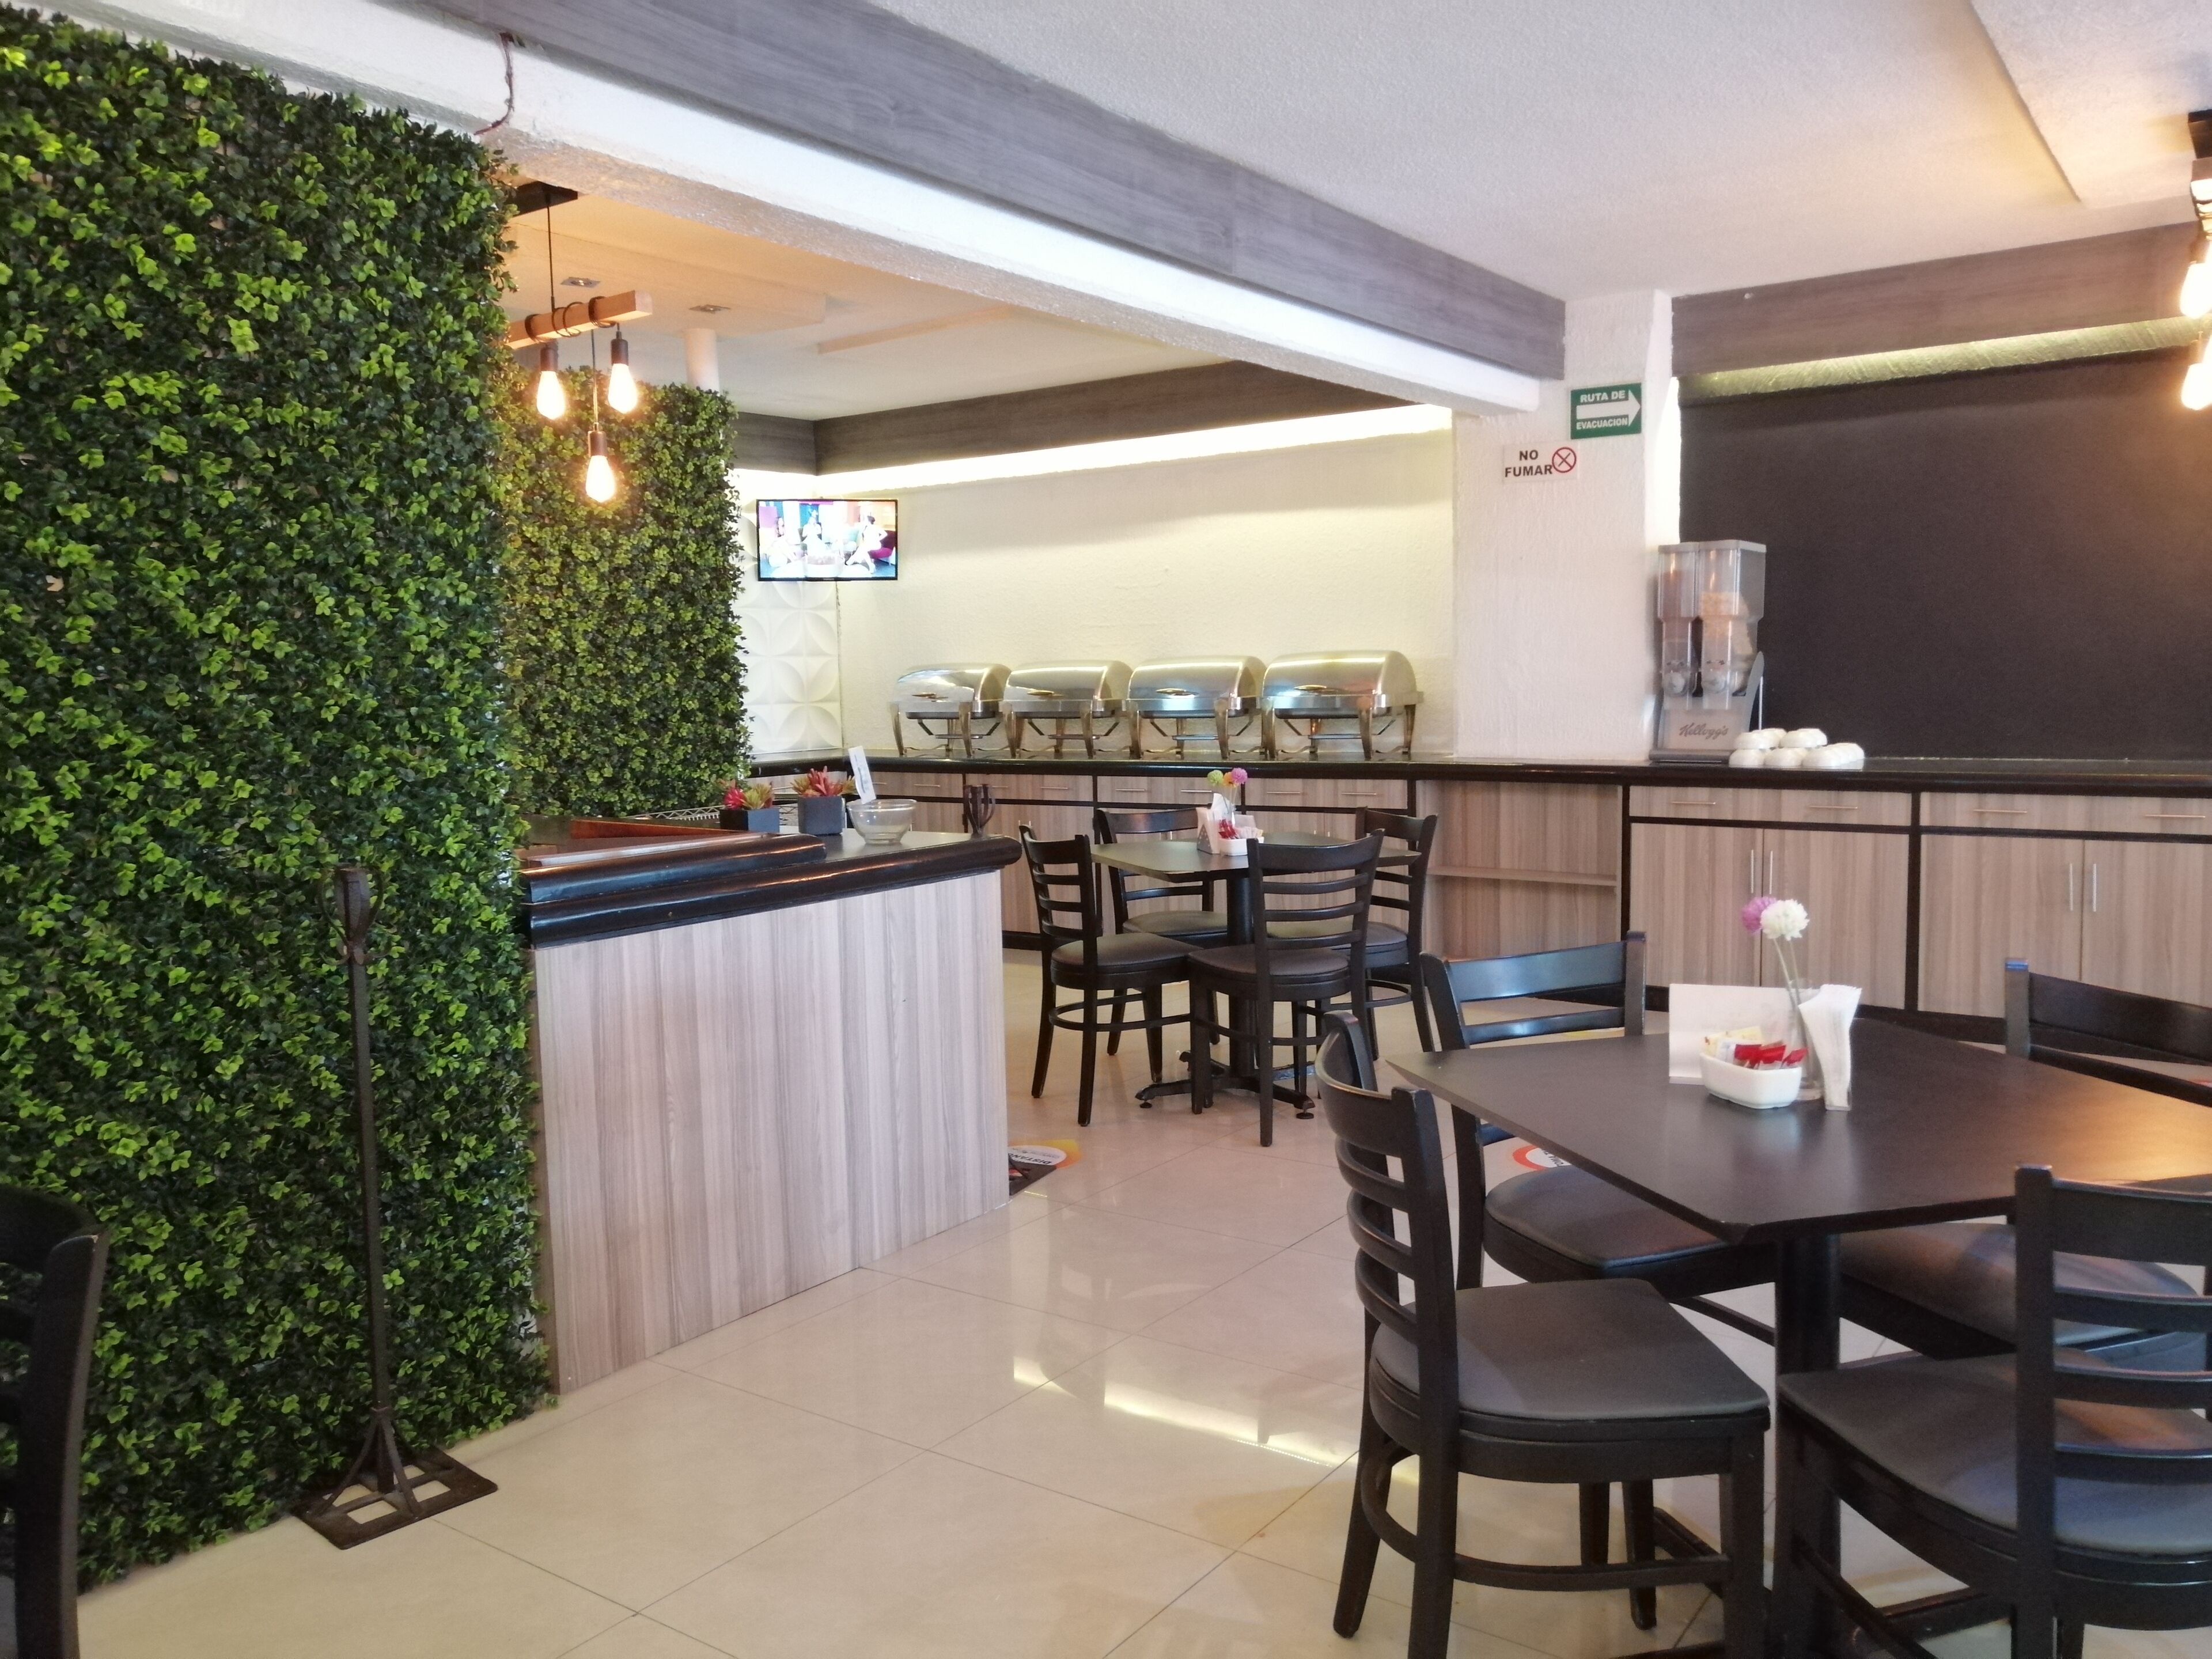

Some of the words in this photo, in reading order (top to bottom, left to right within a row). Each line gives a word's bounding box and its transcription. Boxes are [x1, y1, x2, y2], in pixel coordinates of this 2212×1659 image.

[1580, 392, 1608, 403] RUTA
[1611, 390, 1626, 400] DE
[1576, 418, 1628, 430] EVACUACION
[1519, 449, 1539, 461] NO
[1505, 464, 1552, 478] FUMAR
[1679, 722, 1729, 740] Kellogg's
